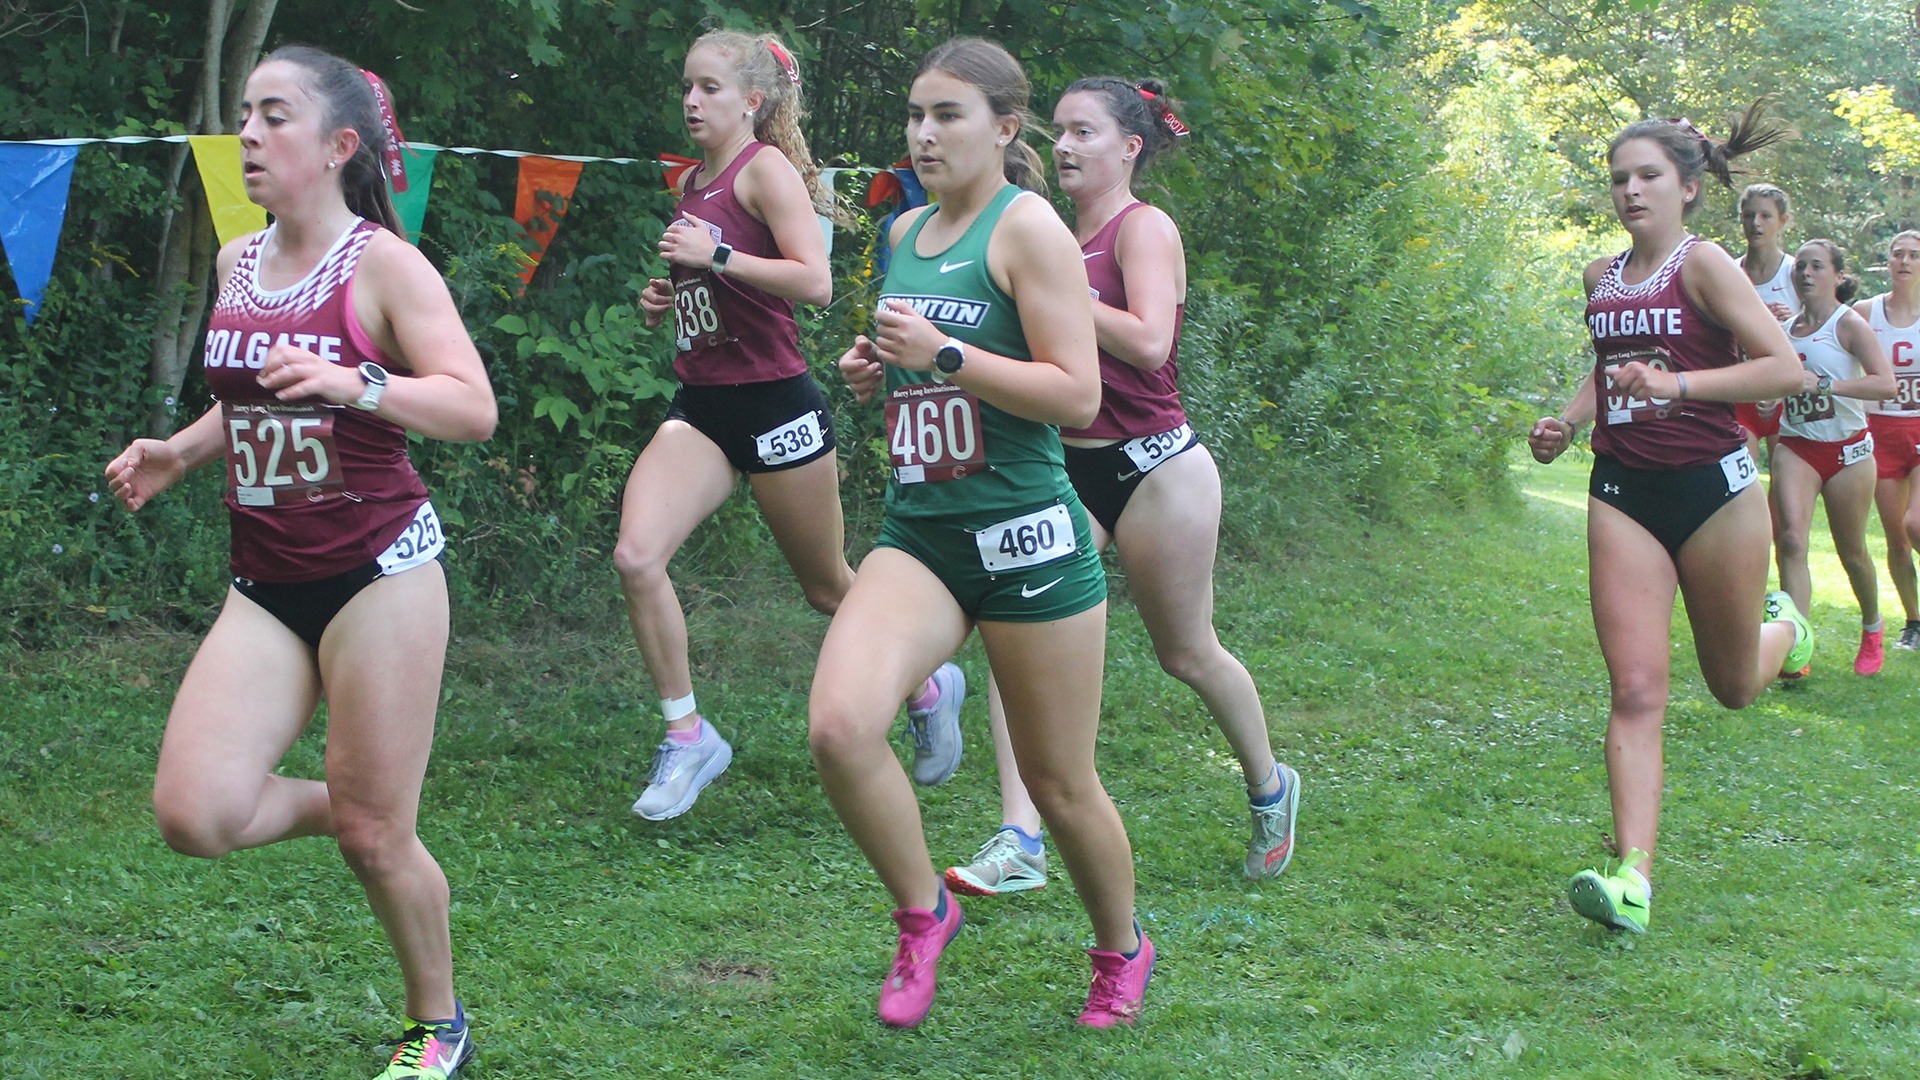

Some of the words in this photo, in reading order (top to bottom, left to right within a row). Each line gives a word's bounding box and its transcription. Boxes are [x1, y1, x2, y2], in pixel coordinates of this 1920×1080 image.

[1588, 308, 1682, 340] COLGATE
[1893, 342, 1913, 367] C
[909, 388, 924, 397] Lang
[770, 423, 813, 457] 538
[892, 397, 976, 464] 460
[230, 418, 329, 487] 525
[395, 512, 437, 560] 525
[999, 519, 1055, 558] 460
